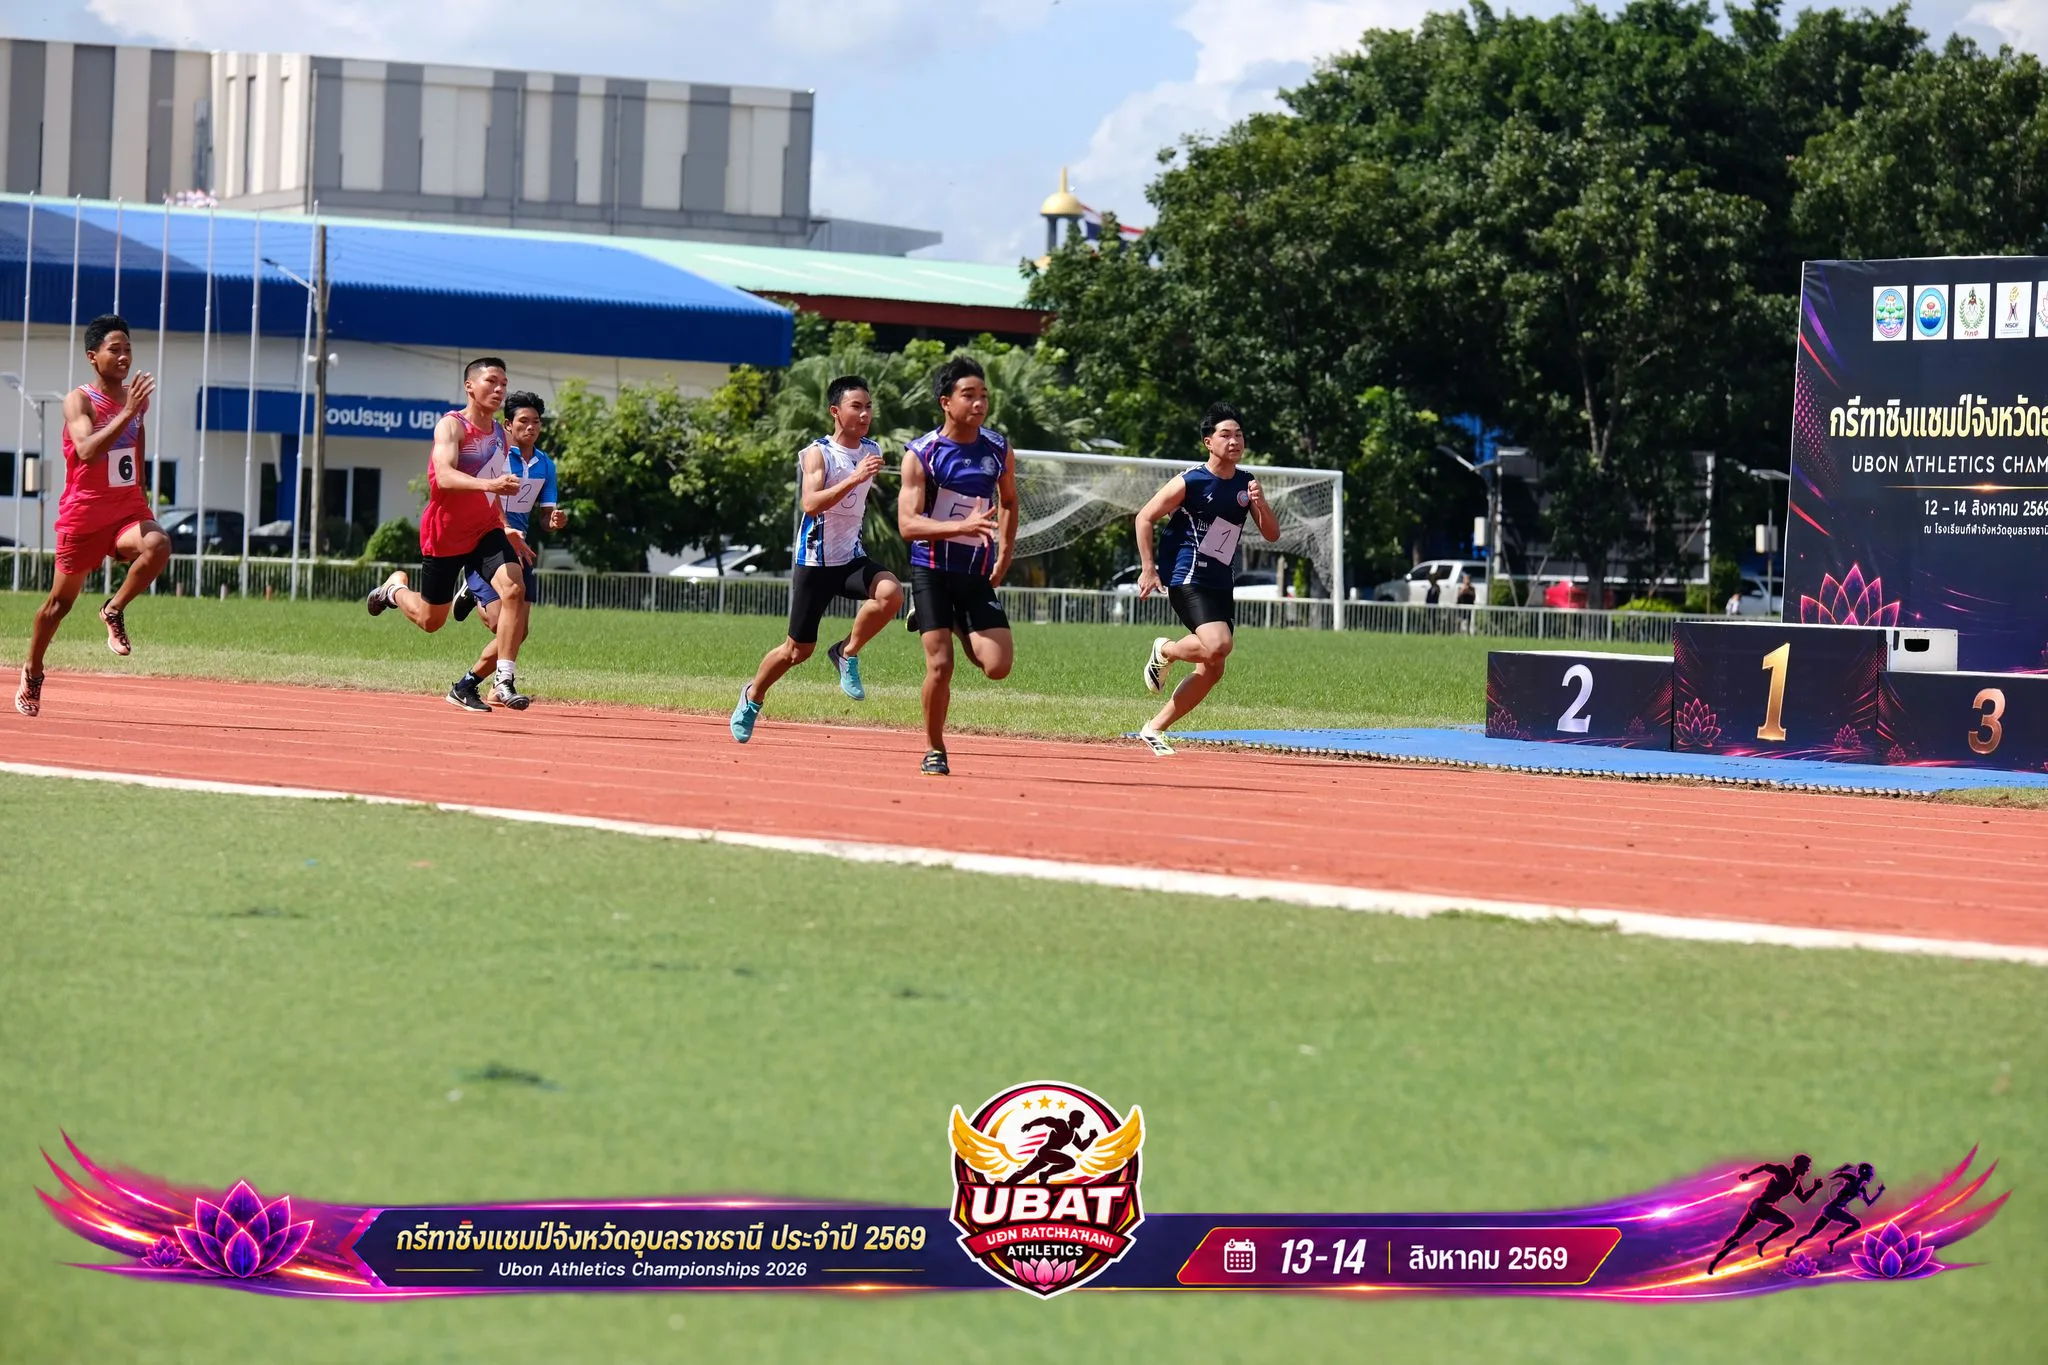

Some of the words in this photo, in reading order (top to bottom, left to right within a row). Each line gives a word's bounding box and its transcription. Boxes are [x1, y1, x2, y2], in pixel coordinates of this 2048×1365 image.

[118, 454, 133, 481] 6
[1852, 456, 1898, 473] UBON
[1905, 456, 1995, 473] ATHLETICS
[517, 483, 532, 504] 2
[1924, 499, 1938, 515] 12
[1953, 499, 1967, 516] 14
[1971, 499, 2018, 516] สิงหาคม
[1214, 529, 1232, 554] 1
[1924, 525, 1932, 534] ณ
[1556, 663, 1594, 734] 2
[1757, 642, 1791, 742] 1
[1968, 687, 2006, 756] 3
